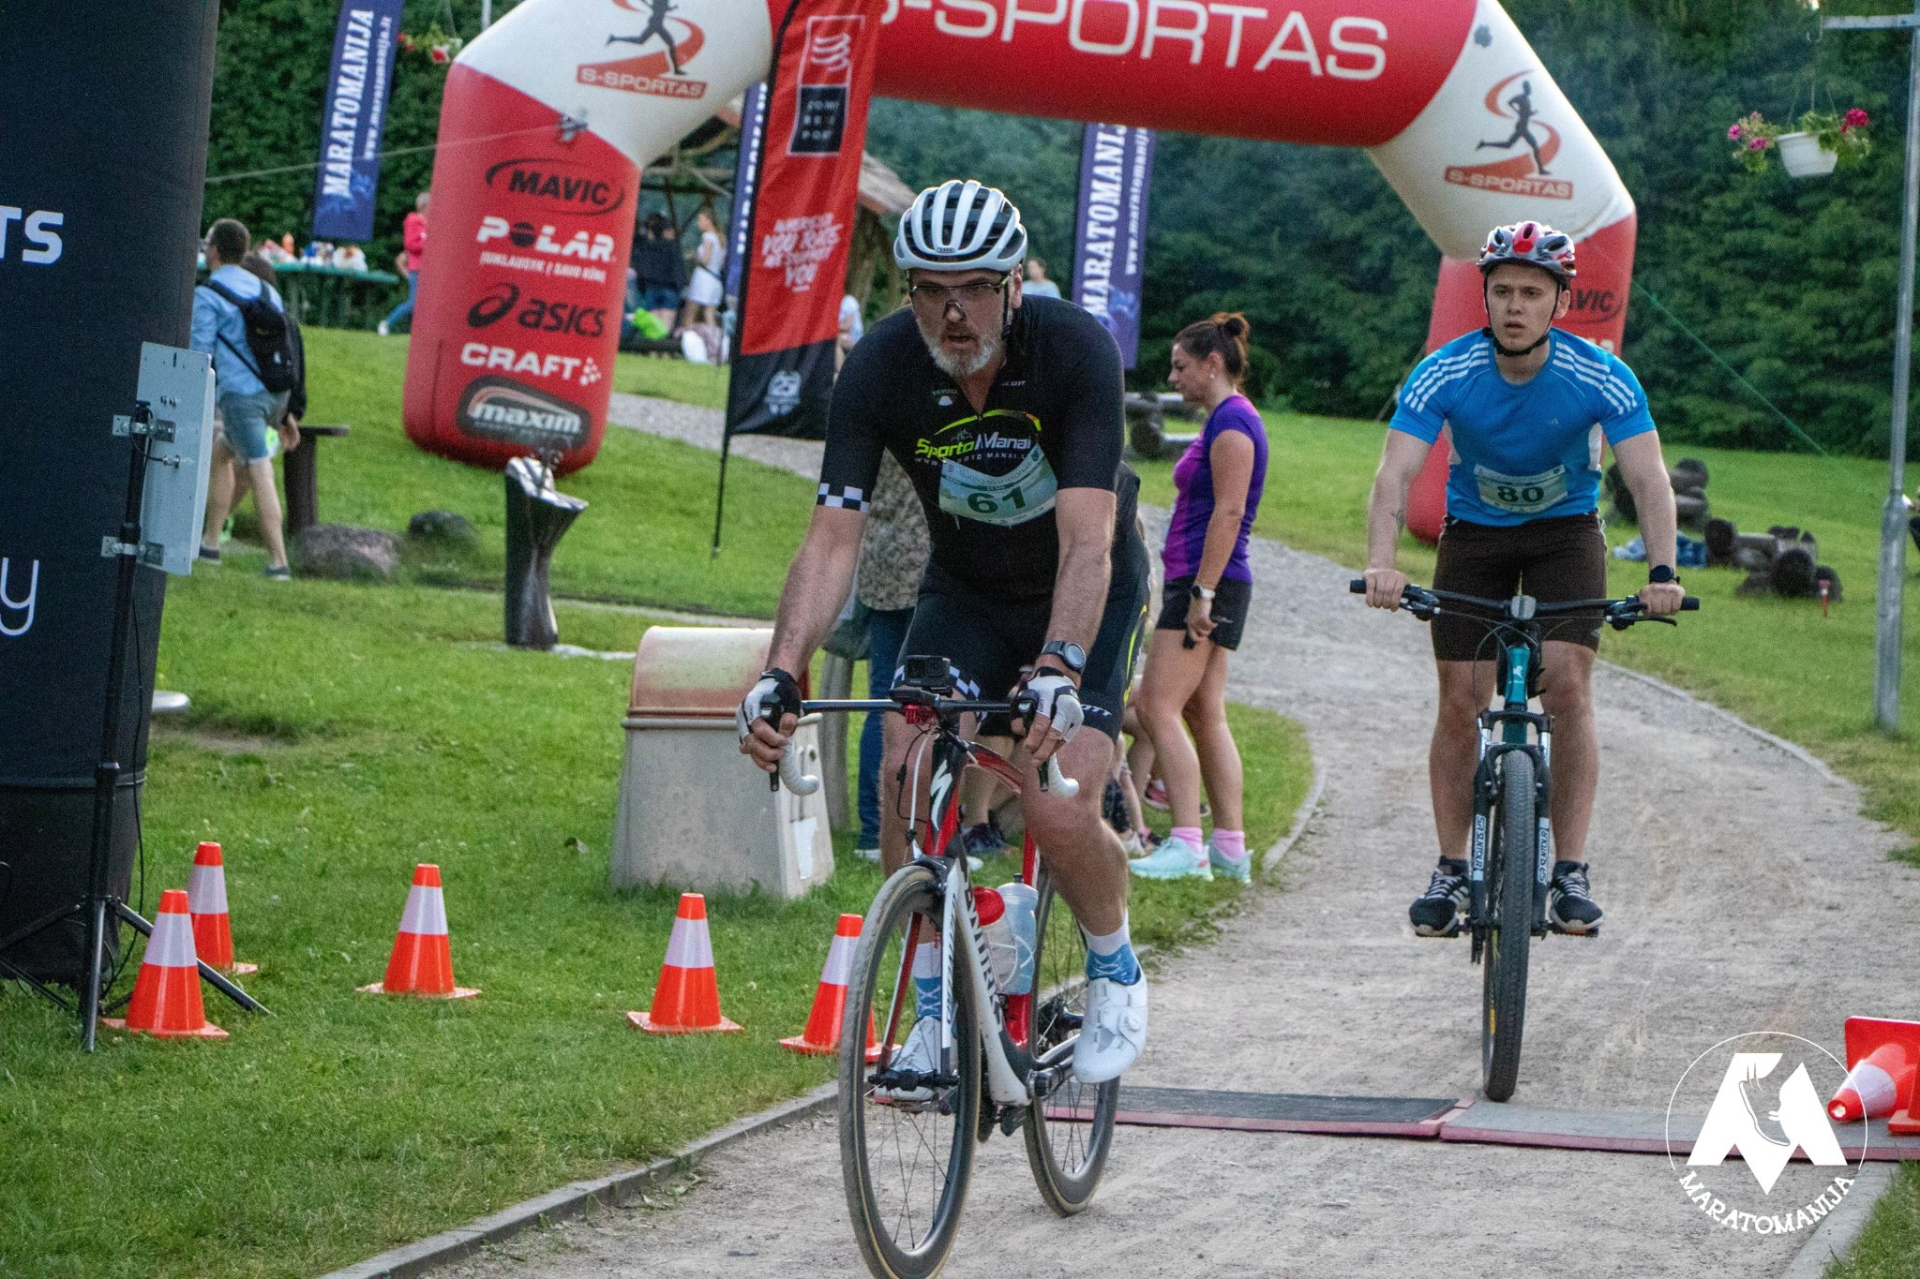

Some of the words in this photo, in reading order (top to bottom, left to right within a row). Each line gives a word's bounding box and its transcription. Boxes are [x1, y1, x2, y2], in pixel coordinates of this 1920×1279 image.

[880, 0, 1388, 80] -SPORTAS
[580, 67, 700, 96] S-SPORTAS
[322, 9, 374, 197] MARATOMANIJA
[508, 169, 610, 206] MAVIC
[1449, 170, 1572, 196] S-SPORTAS
[476, 215, 615, 263] POLAR
[1569, 288, 1614, 313] VIC
[518, 298, 608, 338] asics
[460, 342, 582, 381] CRAFT
[472, 402, 582, 434] maxim
[967, 486, 1026, 514] 61
[1497, 486, 1544, 503] 80
